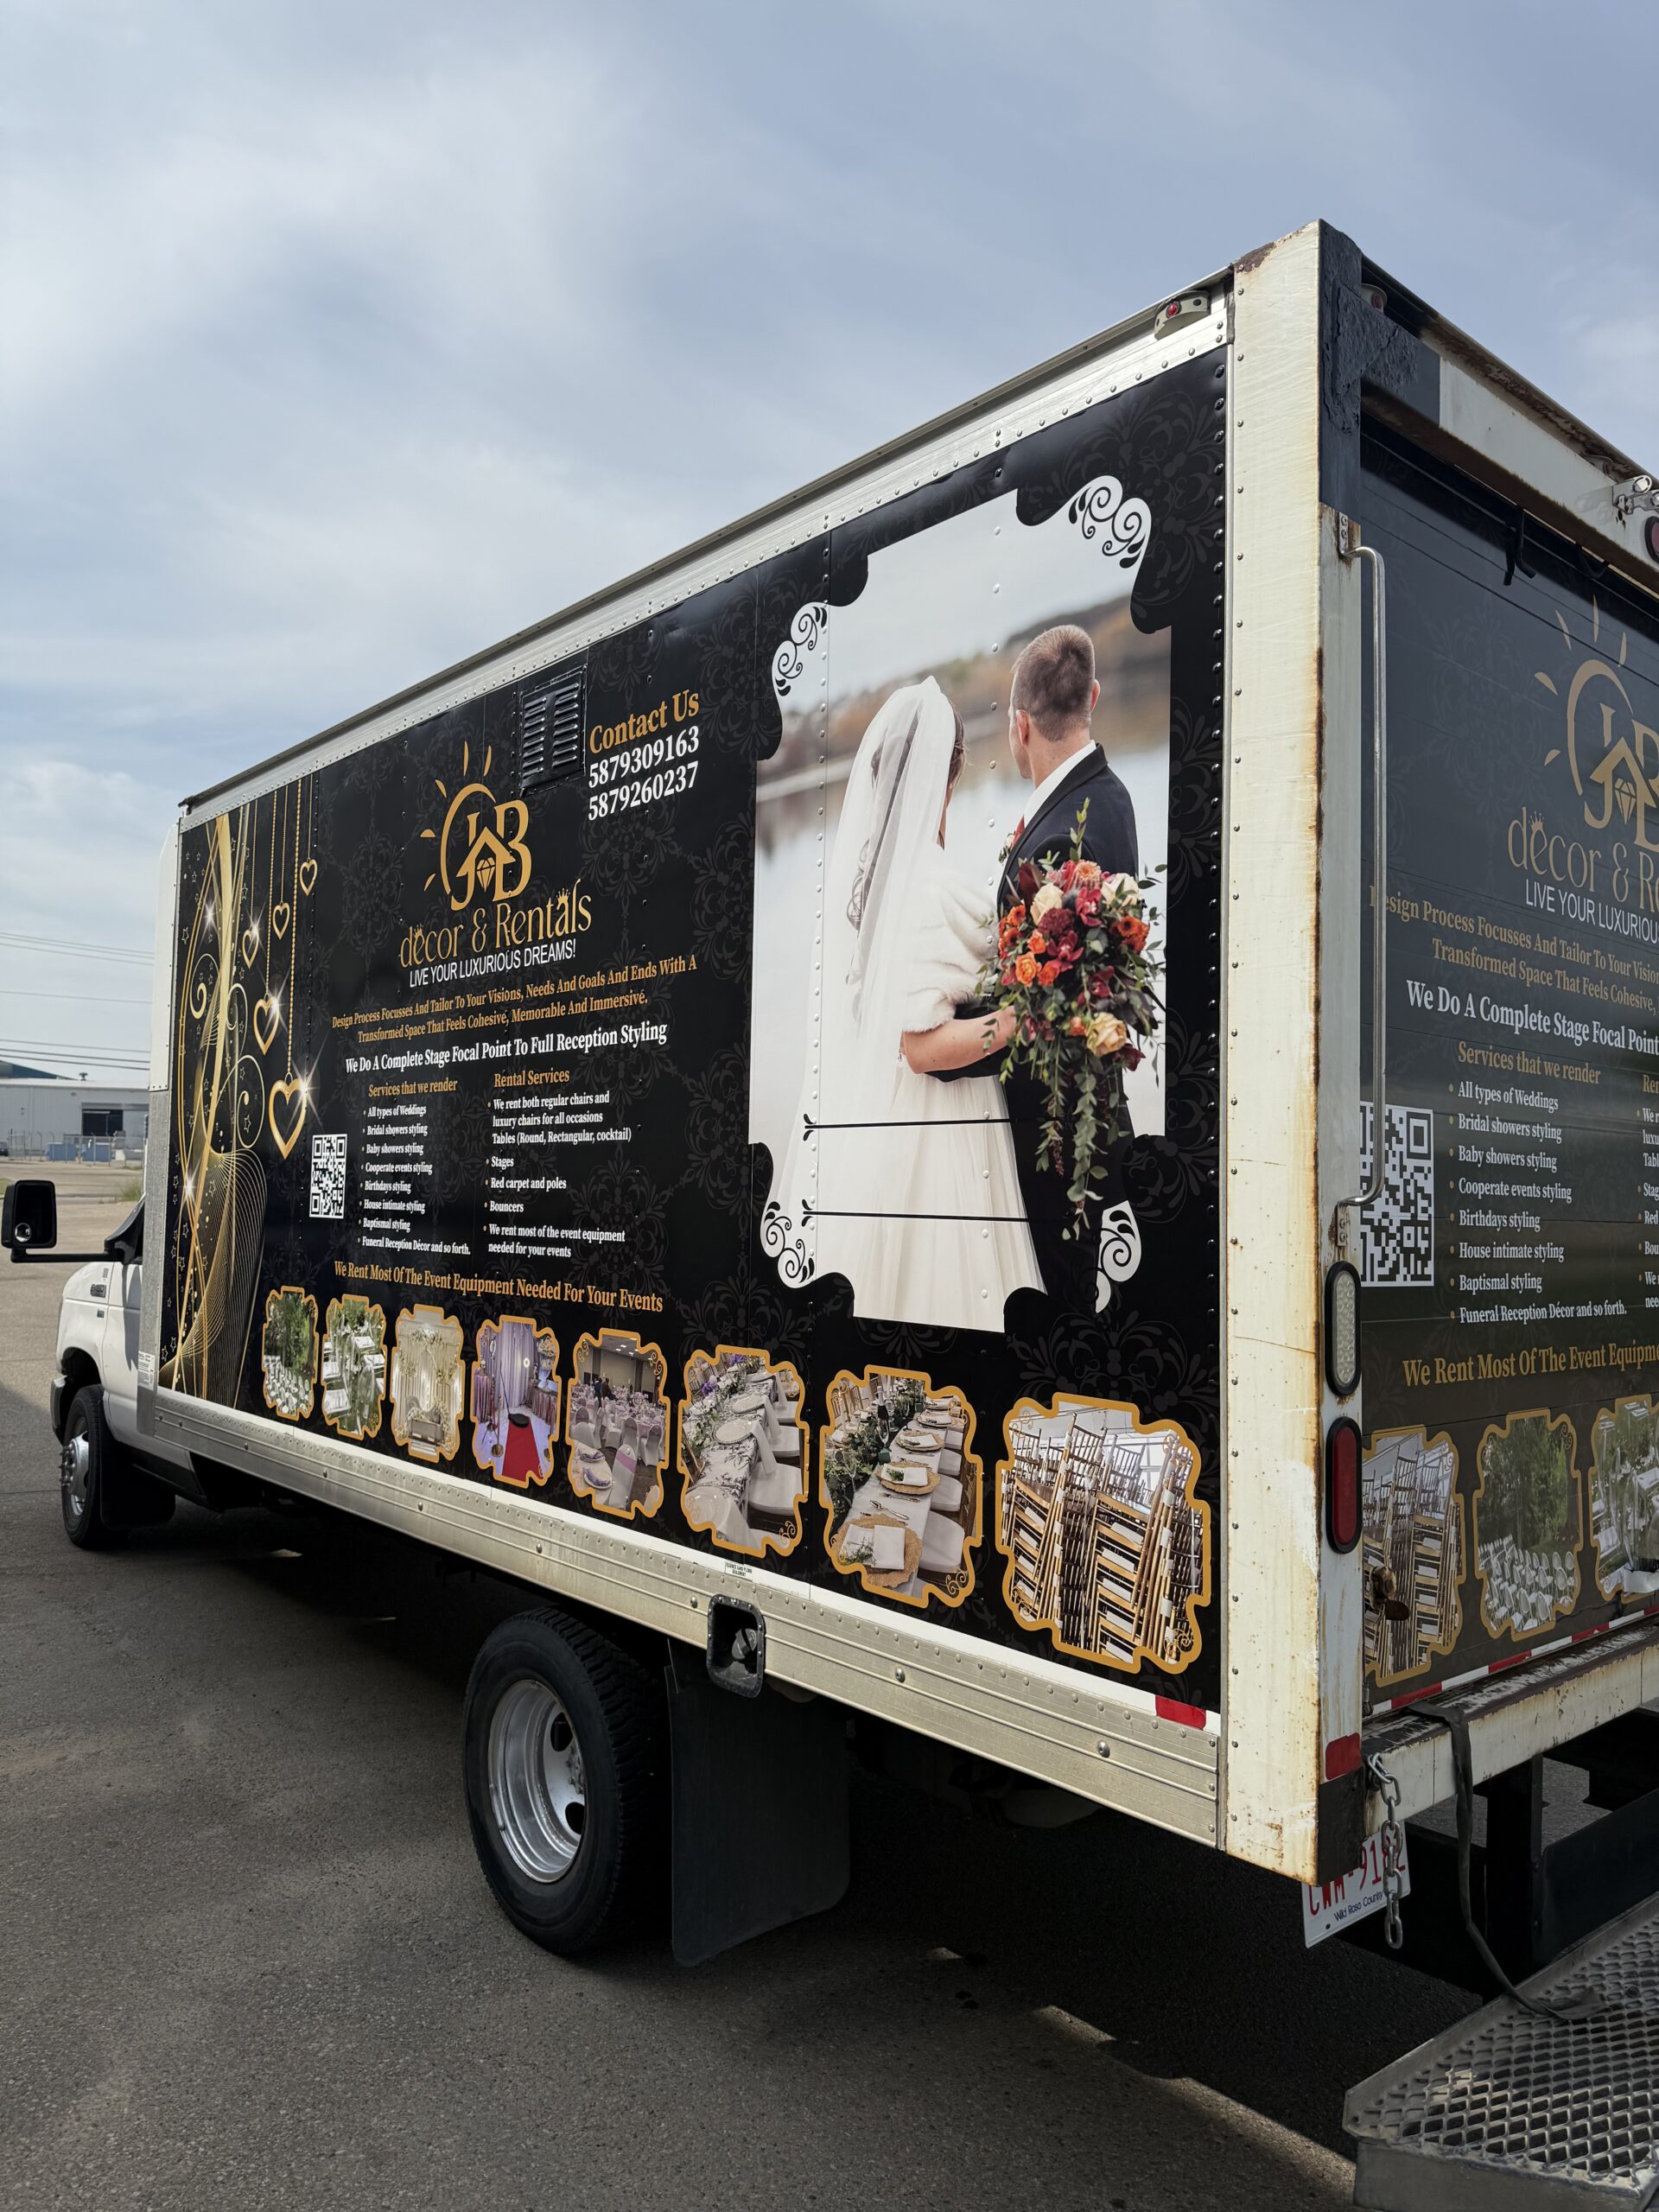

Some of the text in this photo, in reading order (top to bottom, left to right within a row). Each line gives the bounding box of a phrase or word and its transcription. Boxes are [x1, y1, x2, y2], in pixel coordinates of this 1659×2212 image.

[589, 689, 700, 754] Contact Us
[588, 726, 699, 788] 5879309163
[588, 760, 699, 821] 5879260237
[1612, 842, 1629, 903] &
[472, 908, 487, 953] &
[495, 878, 593, 949] Rentals
[1525, 879, 1659, 944] LIVE YOUR LUXURIOU
[1422, 900, 1474, 933] Process
[1478, 916, 1531, 950] Focusses
[1534, 932, 1557, 957] And
[1560, 939, 1592, 965] Tailor
[1593, 950, 1606, 969] To
[1608, 953, 1631, 976] Your
[410, 938, 576, 988] LIVE YOUR LUXURIOUS DREAMS!
[1432, 938, 1656, 1016] Transformed Space That Feels Cohesive,
[332, 954, 697, 1029] Design Process Focusses And Tailor To Your Visions, Needs And Goals And Ends With A
[358, 992, 648, 1043] Transformed Space That Feels Cohesive, Memorable And Immersive.
[1406, 979, 1659, 1056] We Do A Complete Stage Focal Point
[346, 1020, 668, 1073] We Do A Complete Stage Focal Point To Full Reception Styling
[1458, 1040, 1601, 1084] Services that we render
[368, 1077, 458, 1097] Services that we render
[493, 1067, 570, 1088] Rental Services
[493, 1090, 610, 1110] We rent both regular chairs and
[1458, 1081, 1559, 1114] All types of Weddings
[493, 1110, 603, 1129] luxury chairs for all occasions
[1458, 1113, 1562, 1144] Bridal showers styling
[492, 1128, 632, 1146] Tables (Round, Rectangular, cocktail)
[365, 1161, 433, 1175] Cooperate events styling
[491, 1155, 514, 1170] Stages
[1458, 1145, 1558, 1173] Baby showers styling
[490, 1177, 567, 1192] Red carpet and poles
[489, 1200, 524, 1212] Bouncers
[363, 1217, 411, 1233] Baptismal styling
[488, 1224, 626, 1244] We rent most of the event equipment
[362, 1236, 385, 1248] Funeral
[385, 1237, 412, 1251] Reception
[430, 1241, 443, 1253] and
[443, 1243, 451, 1253] so
[451, 1242, 471, 1255] forth.
[488, 1241, 572, 1258] needed for your events
[334, 1261, 664, 1313] We Rent Most Of The Event Equipment Needed For Your Events
[1402, 1358, 1431, 1387] We
[1434, 1356, 1474, 1384] Rent
[1477, 1352, 1516, 1380] Most
[1518, 1348, 1536, 1376] Of
[1538, 1346, 1567, 1373] The
[1569, 1344, 1606, 1370] Event
[1333, 1910, 1347, 1922] Wild
[1363, 1891, 1384, 1907] County
